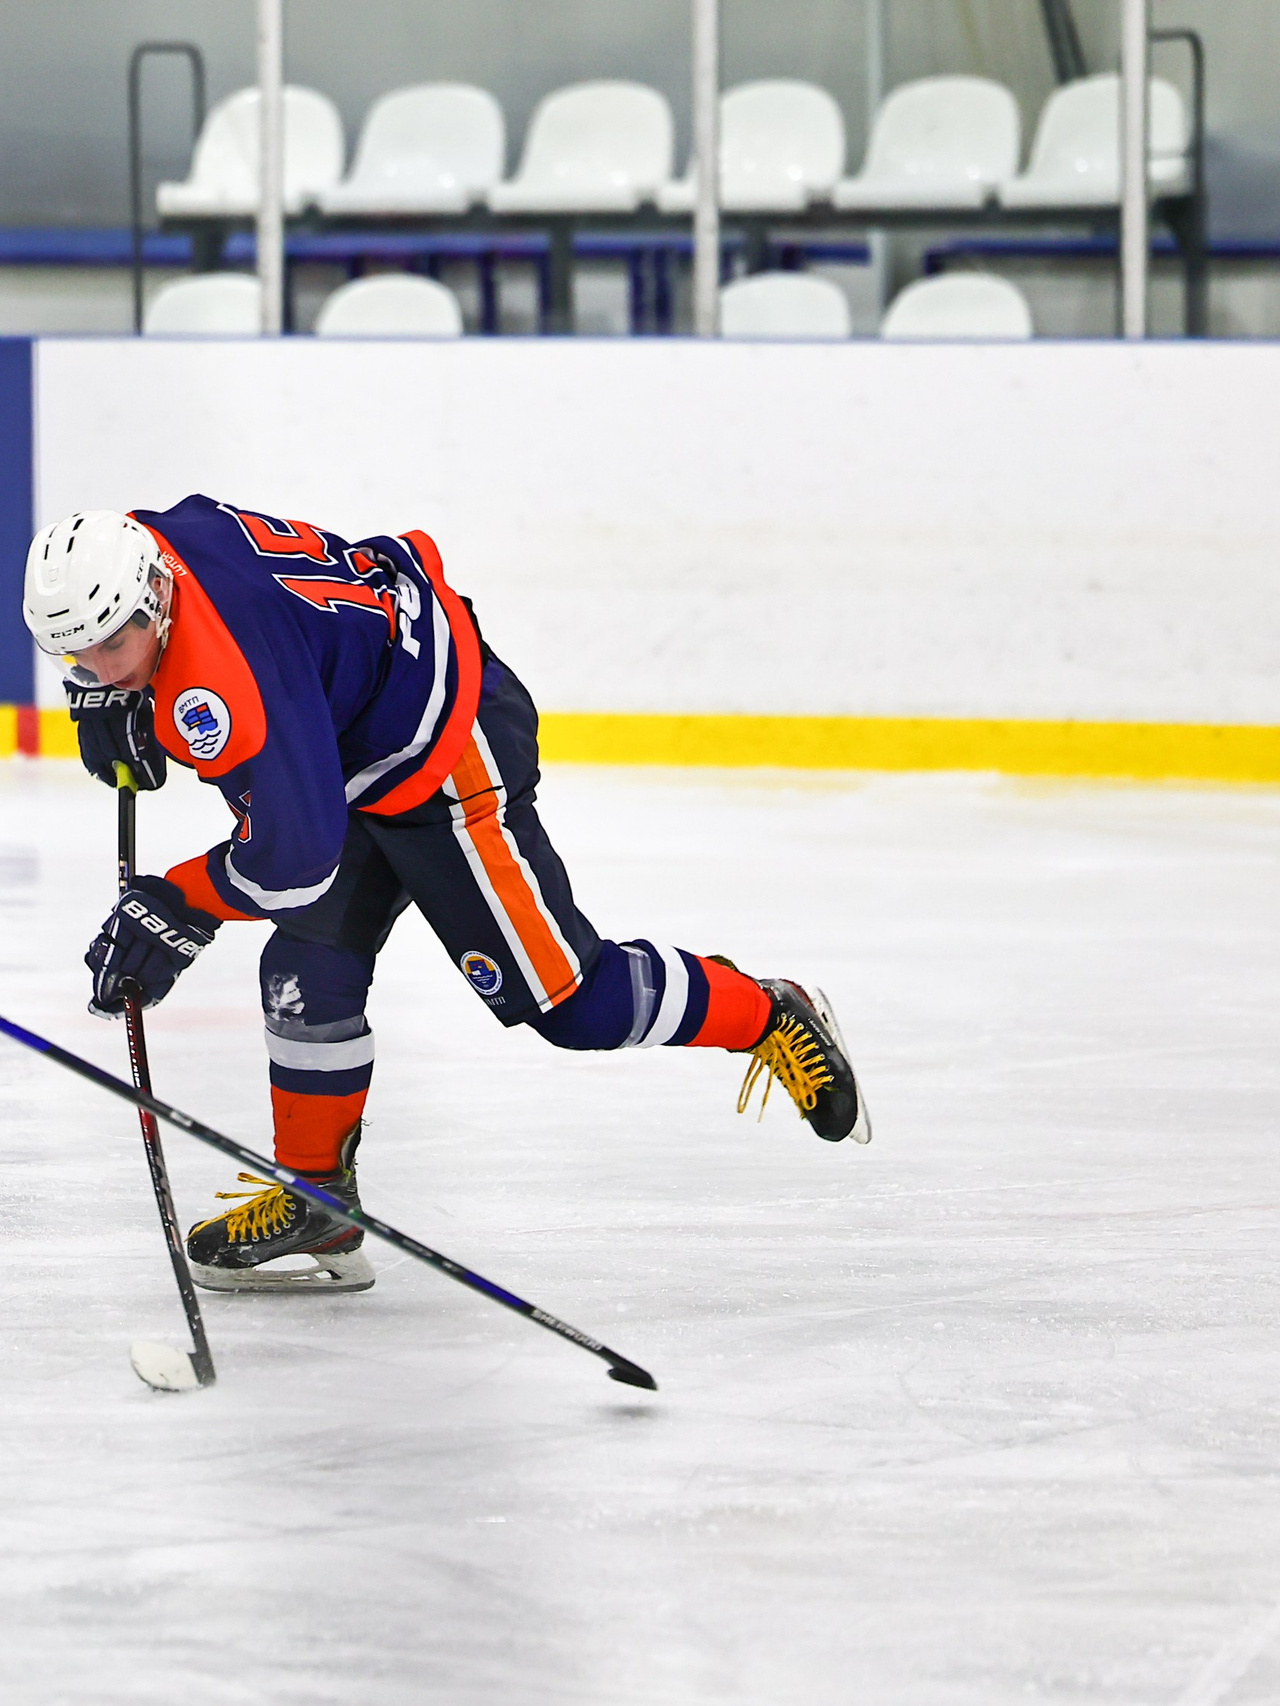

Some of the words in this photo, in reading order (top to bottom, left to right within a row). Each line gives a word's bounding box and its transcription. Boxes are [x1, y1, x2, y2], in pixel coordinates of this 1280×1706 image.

[161, 550, 187, 577] LUTCH
[50, 624, 85, 639] CCM
[67, 690, 131, 709] UER
[121, 900, 205, 958] BAUER
